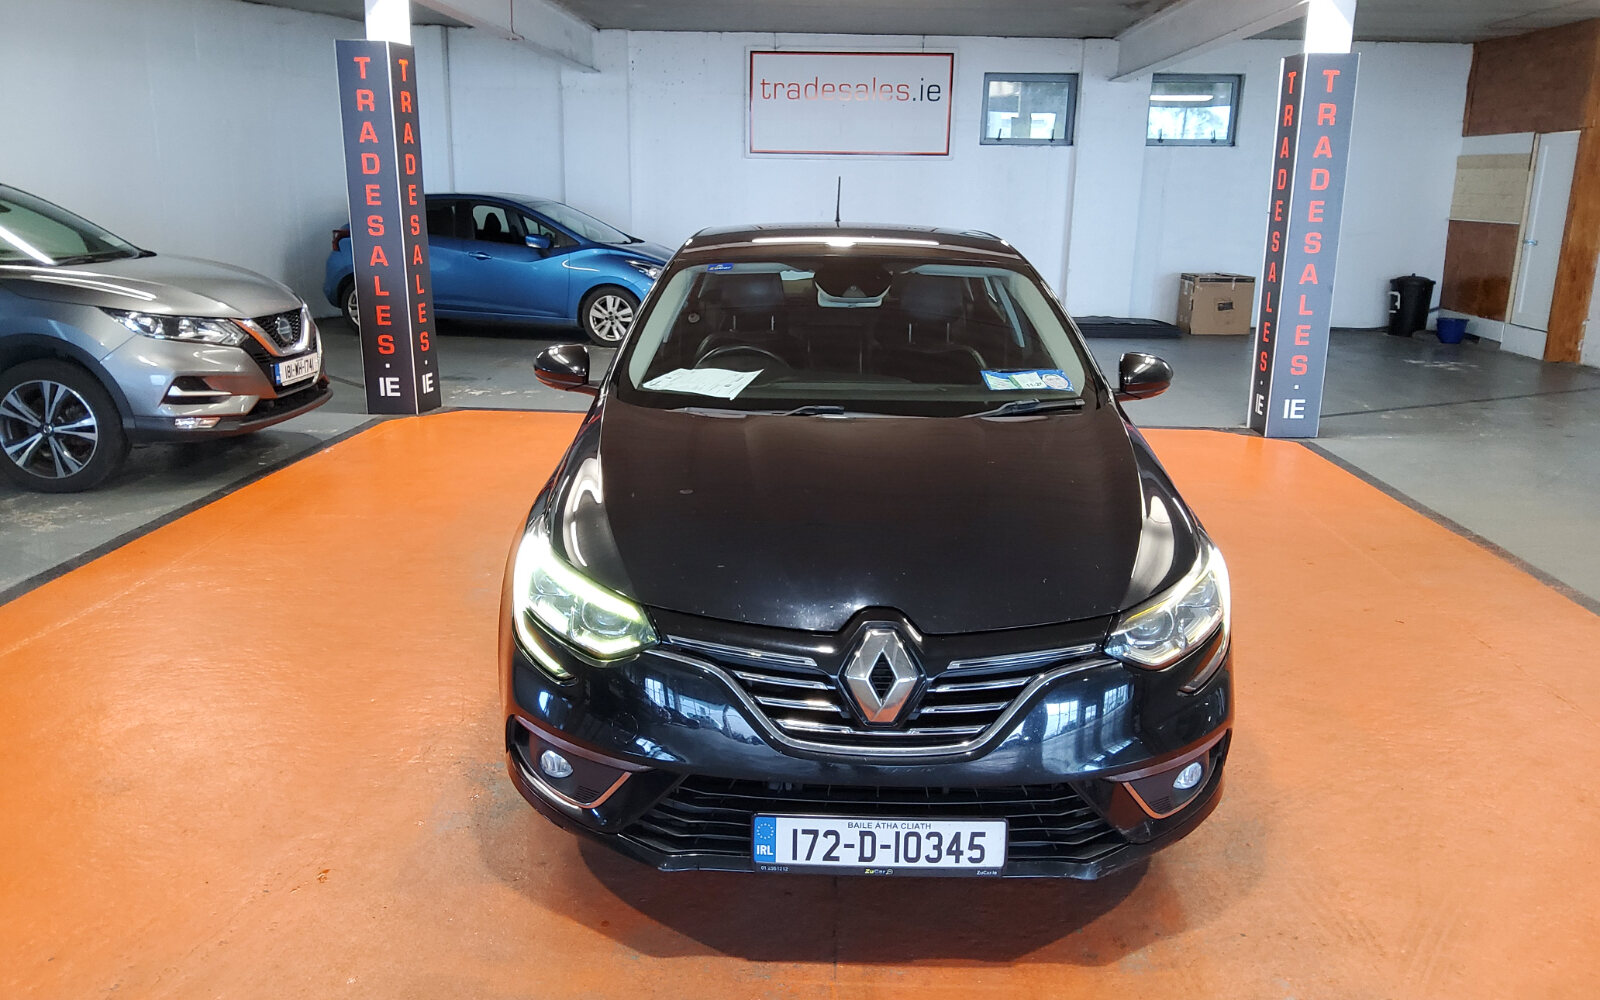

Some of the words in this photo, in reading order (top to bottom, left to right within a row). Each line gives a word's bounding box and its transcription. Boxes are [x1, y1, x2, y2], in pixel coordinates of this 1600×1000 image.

[760, 76, 942, 102] tradesales.ie
[847, 821, 873, 829] BAILE
[900, 822, 932, 830] CLIATH
[756, 844, 774, 856] IRL
[791, 828, 986, 864] 172-D-10345
